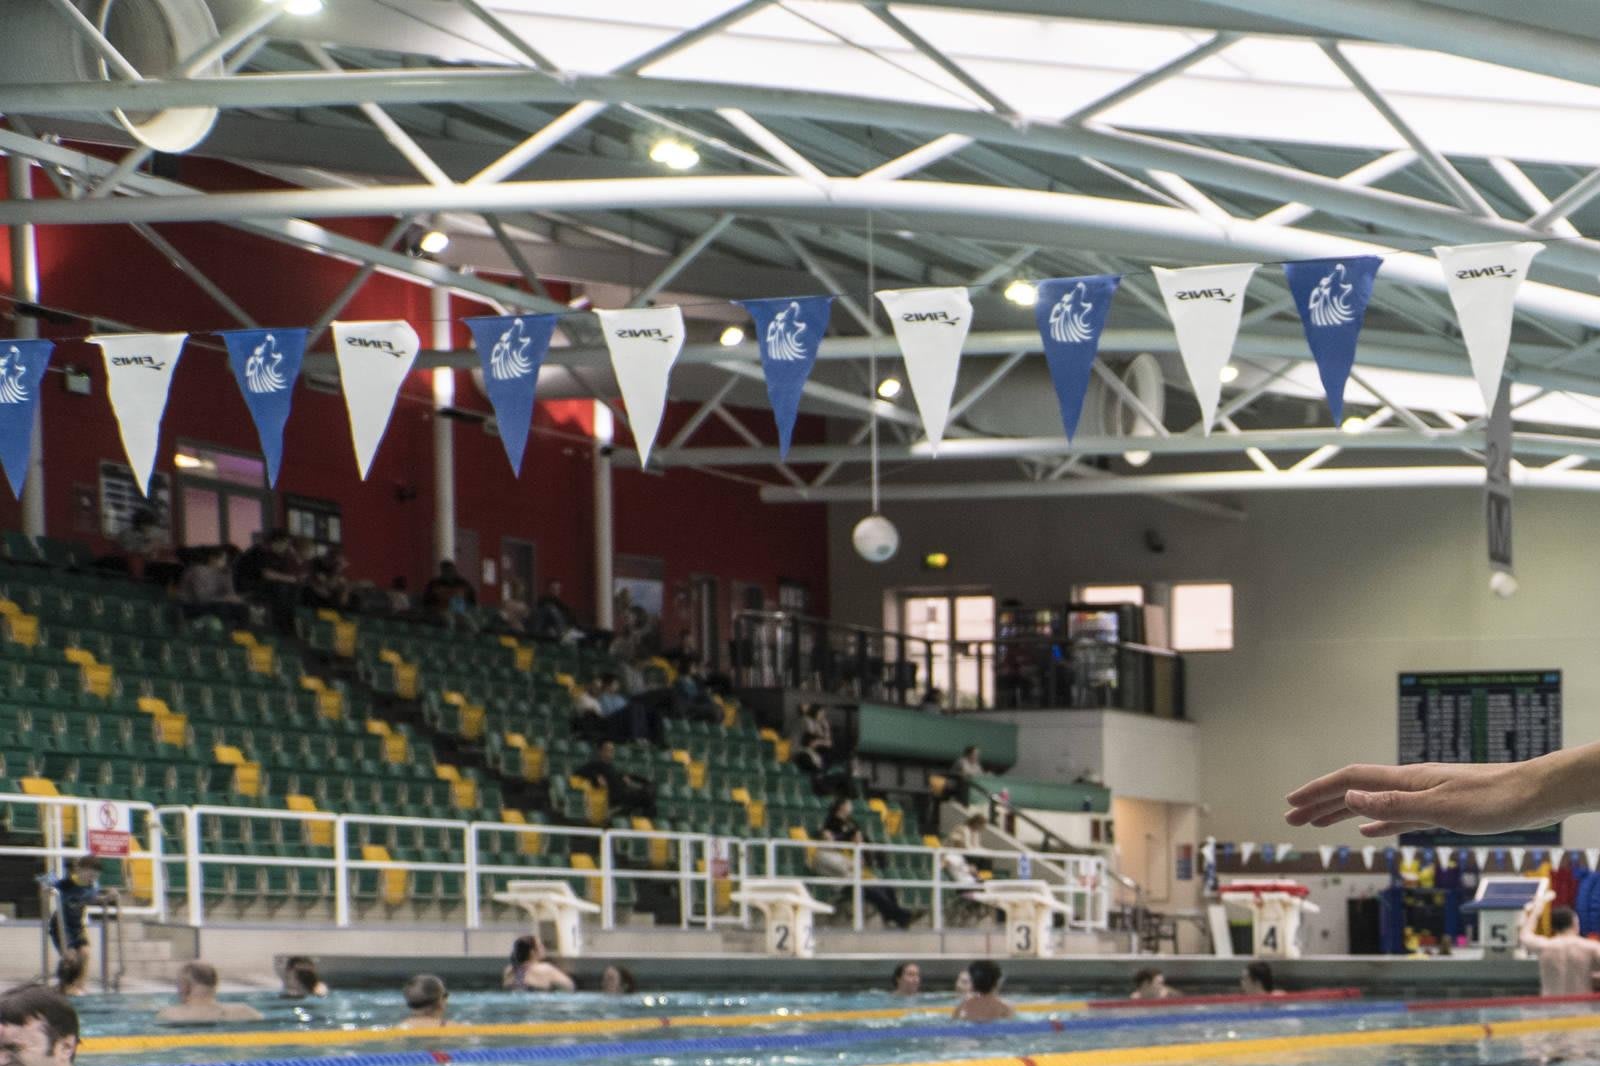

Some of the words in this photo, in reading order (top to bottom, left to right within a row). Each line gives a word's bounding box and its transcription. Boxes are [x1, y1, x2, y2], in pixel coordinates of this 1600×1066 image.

[775, 924, 790, 951] 2
[1016, 924, 1032, 951] 3
[1262, 925, 1278, 952] 4
[1491, 924, 1507, 952] 5
